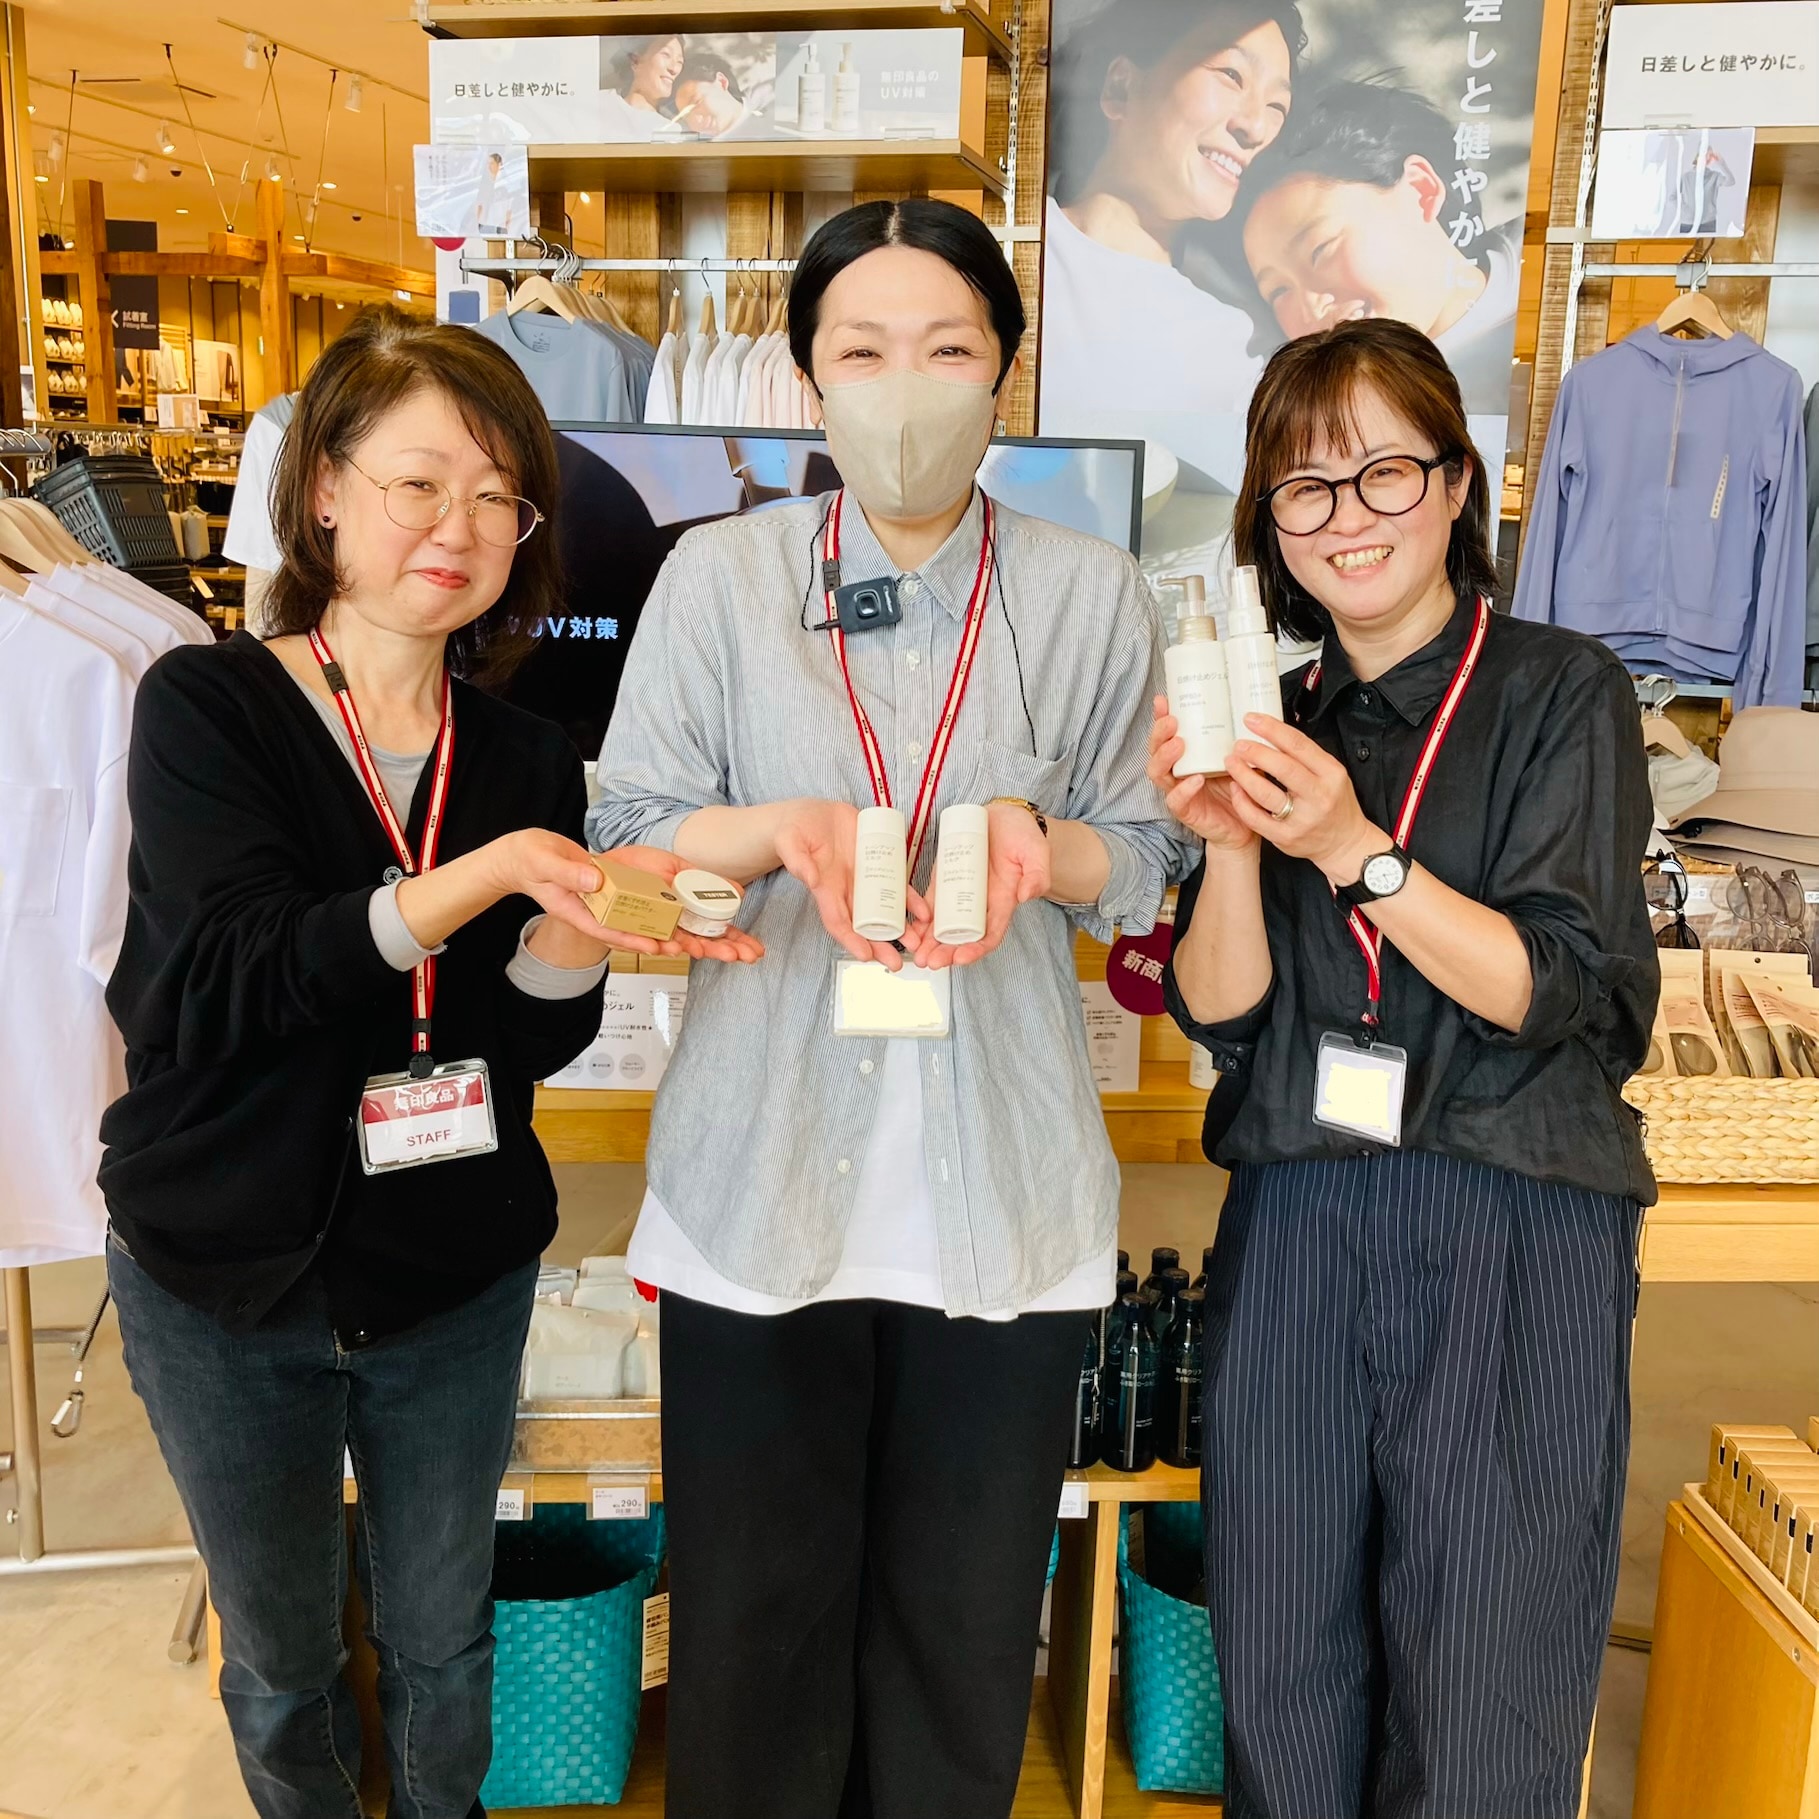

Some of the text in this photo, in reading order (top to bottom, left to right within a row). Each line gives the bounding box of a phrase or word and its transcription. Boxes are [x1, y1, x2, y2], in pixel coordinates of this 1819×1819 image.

[1641, 54, 1806, 73] 日差しと健やかに。
[454, 82, 576, 98] 日差しと健やかに。
[1449, 0, 1502, 266] 差しと健やか
[1122, 949, 1165, 985] 新商
[406, 1129, 452, 1147] STAFF
[498, 1501, 516, 1510] 290
[621, 1499, 638, 1508] 290
